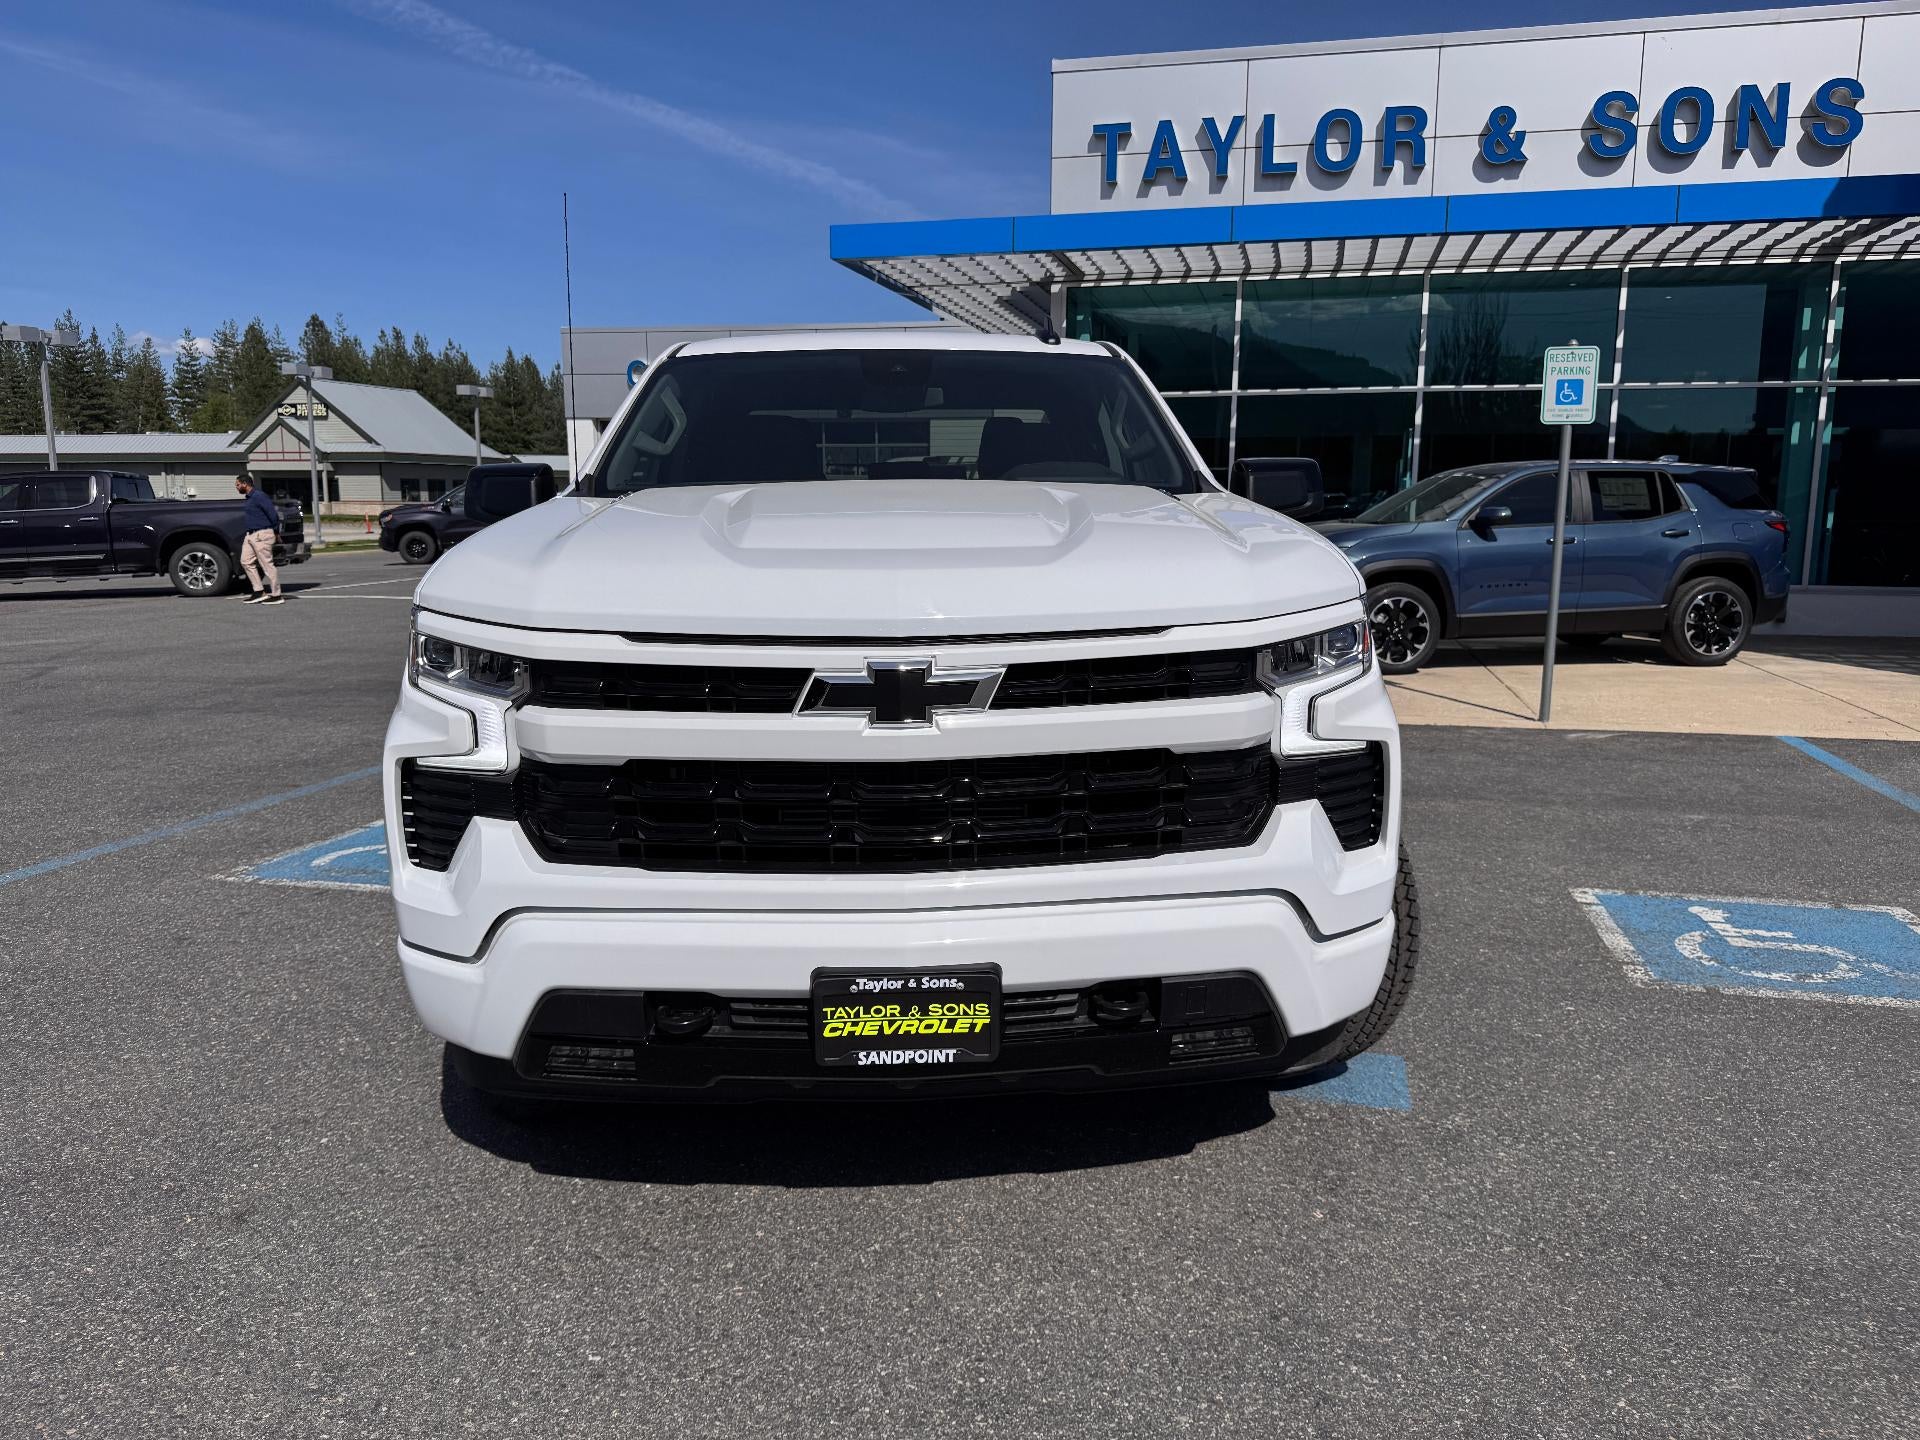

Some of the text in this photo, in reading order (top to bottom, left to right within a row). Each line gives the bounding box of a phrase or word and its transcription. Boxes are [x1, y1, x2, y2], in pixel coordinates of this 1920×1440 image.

[1092, 77, 1865, 184] TAYLOR & SONS
[1549, 353, 1594, 363] RESERVED
[1550, 366, 1591, 376] PARKING
[855, 976, 957, 992] Taylor & Sons
[822, 1003, 990, 1019] TAYLOR & SONS
[822, 1018, 990, 1037] CHEVROLET
[857, 1049, 957, 1066] SANDPOINT
